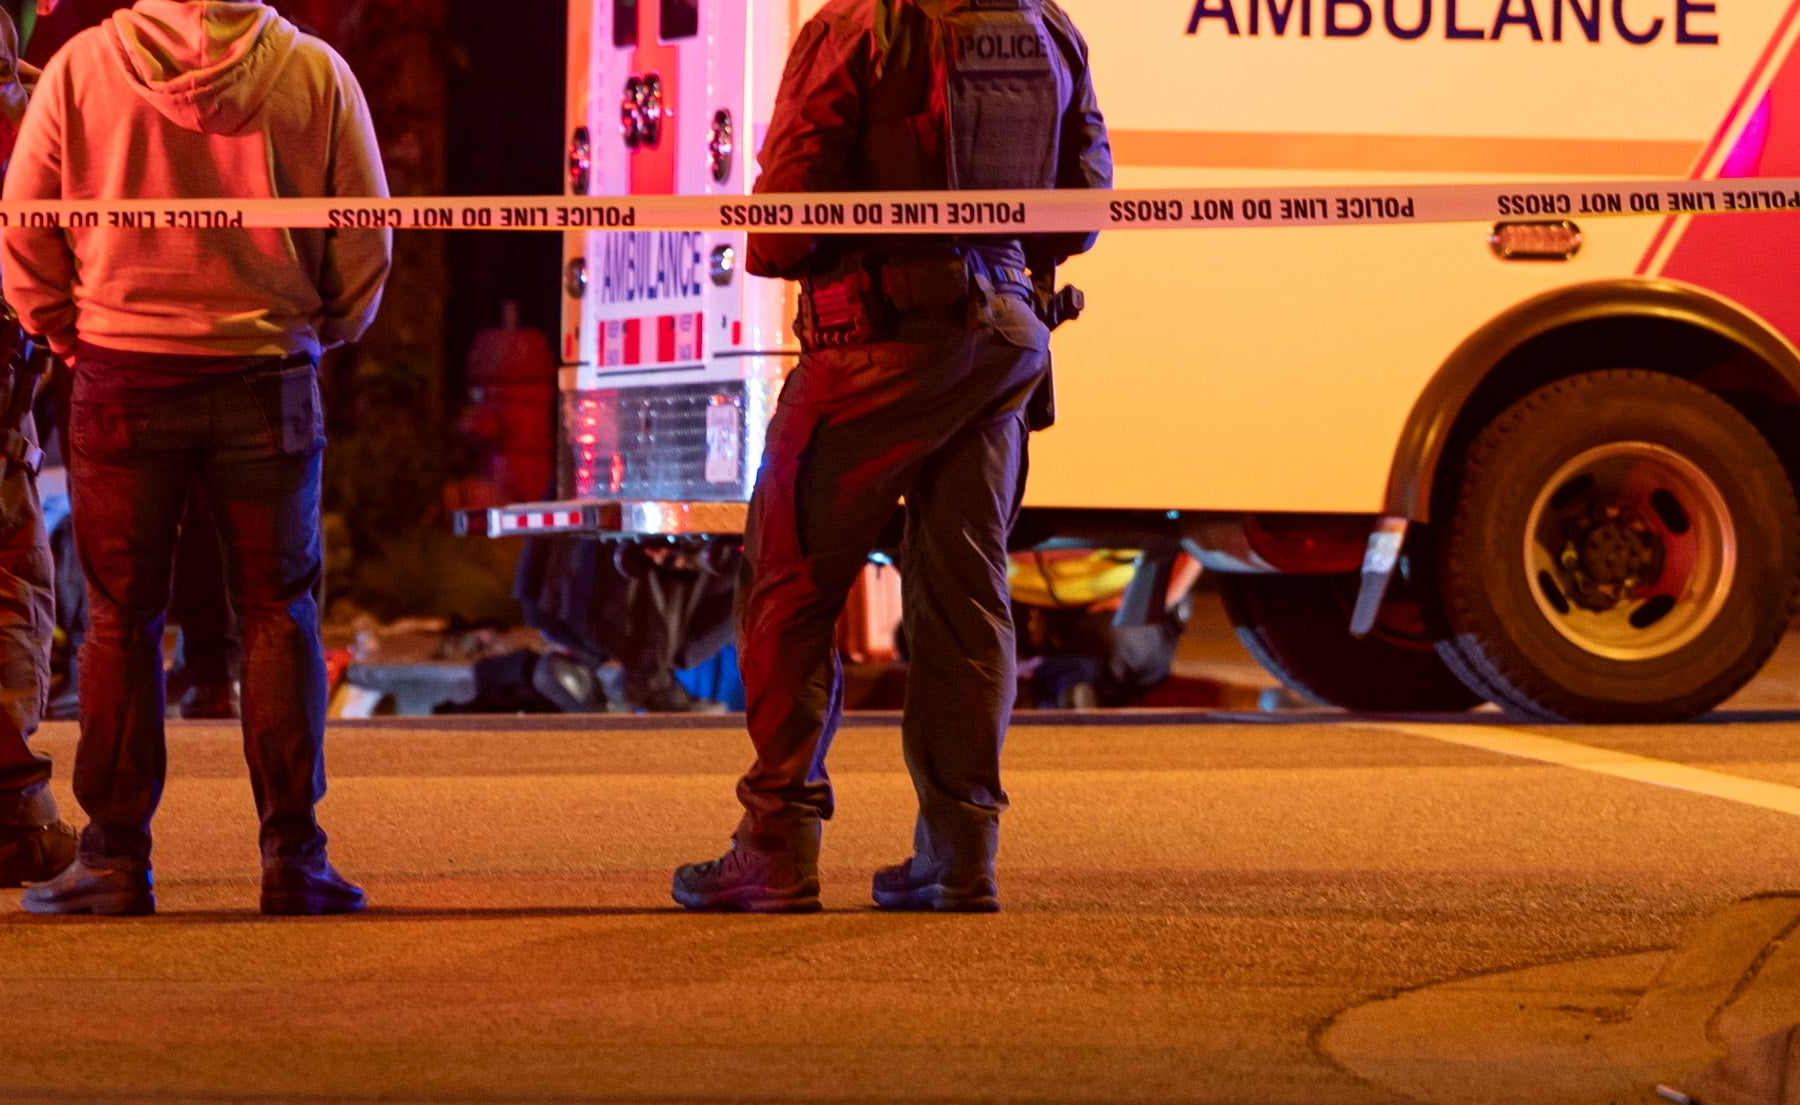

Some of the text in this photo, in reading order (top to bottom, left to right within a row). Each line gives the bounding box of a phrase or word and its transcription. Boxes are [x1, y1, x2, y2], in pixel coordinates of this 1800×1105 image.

[958, 34, 1050, 60] POLICE
[719, 202, 1026, 226] POLICE LINE DO NOT CROSS
[1109, 197, 1415, 223] POLICE LINE DO NOT CROSS
[1497, 189, 1800, 216] POLICE LINE DO NOT CROSS
[20, 211, 61, 228] NOT
[69, 211, 100, 228] DO
[108, 210, 156, 228] LINE
[164, 209, 244, 228] POLICE
[328, 206, 636, 228] POLICE LINE DO NOT CROSS
[601, 230, 701, 304] AMBULANCE
